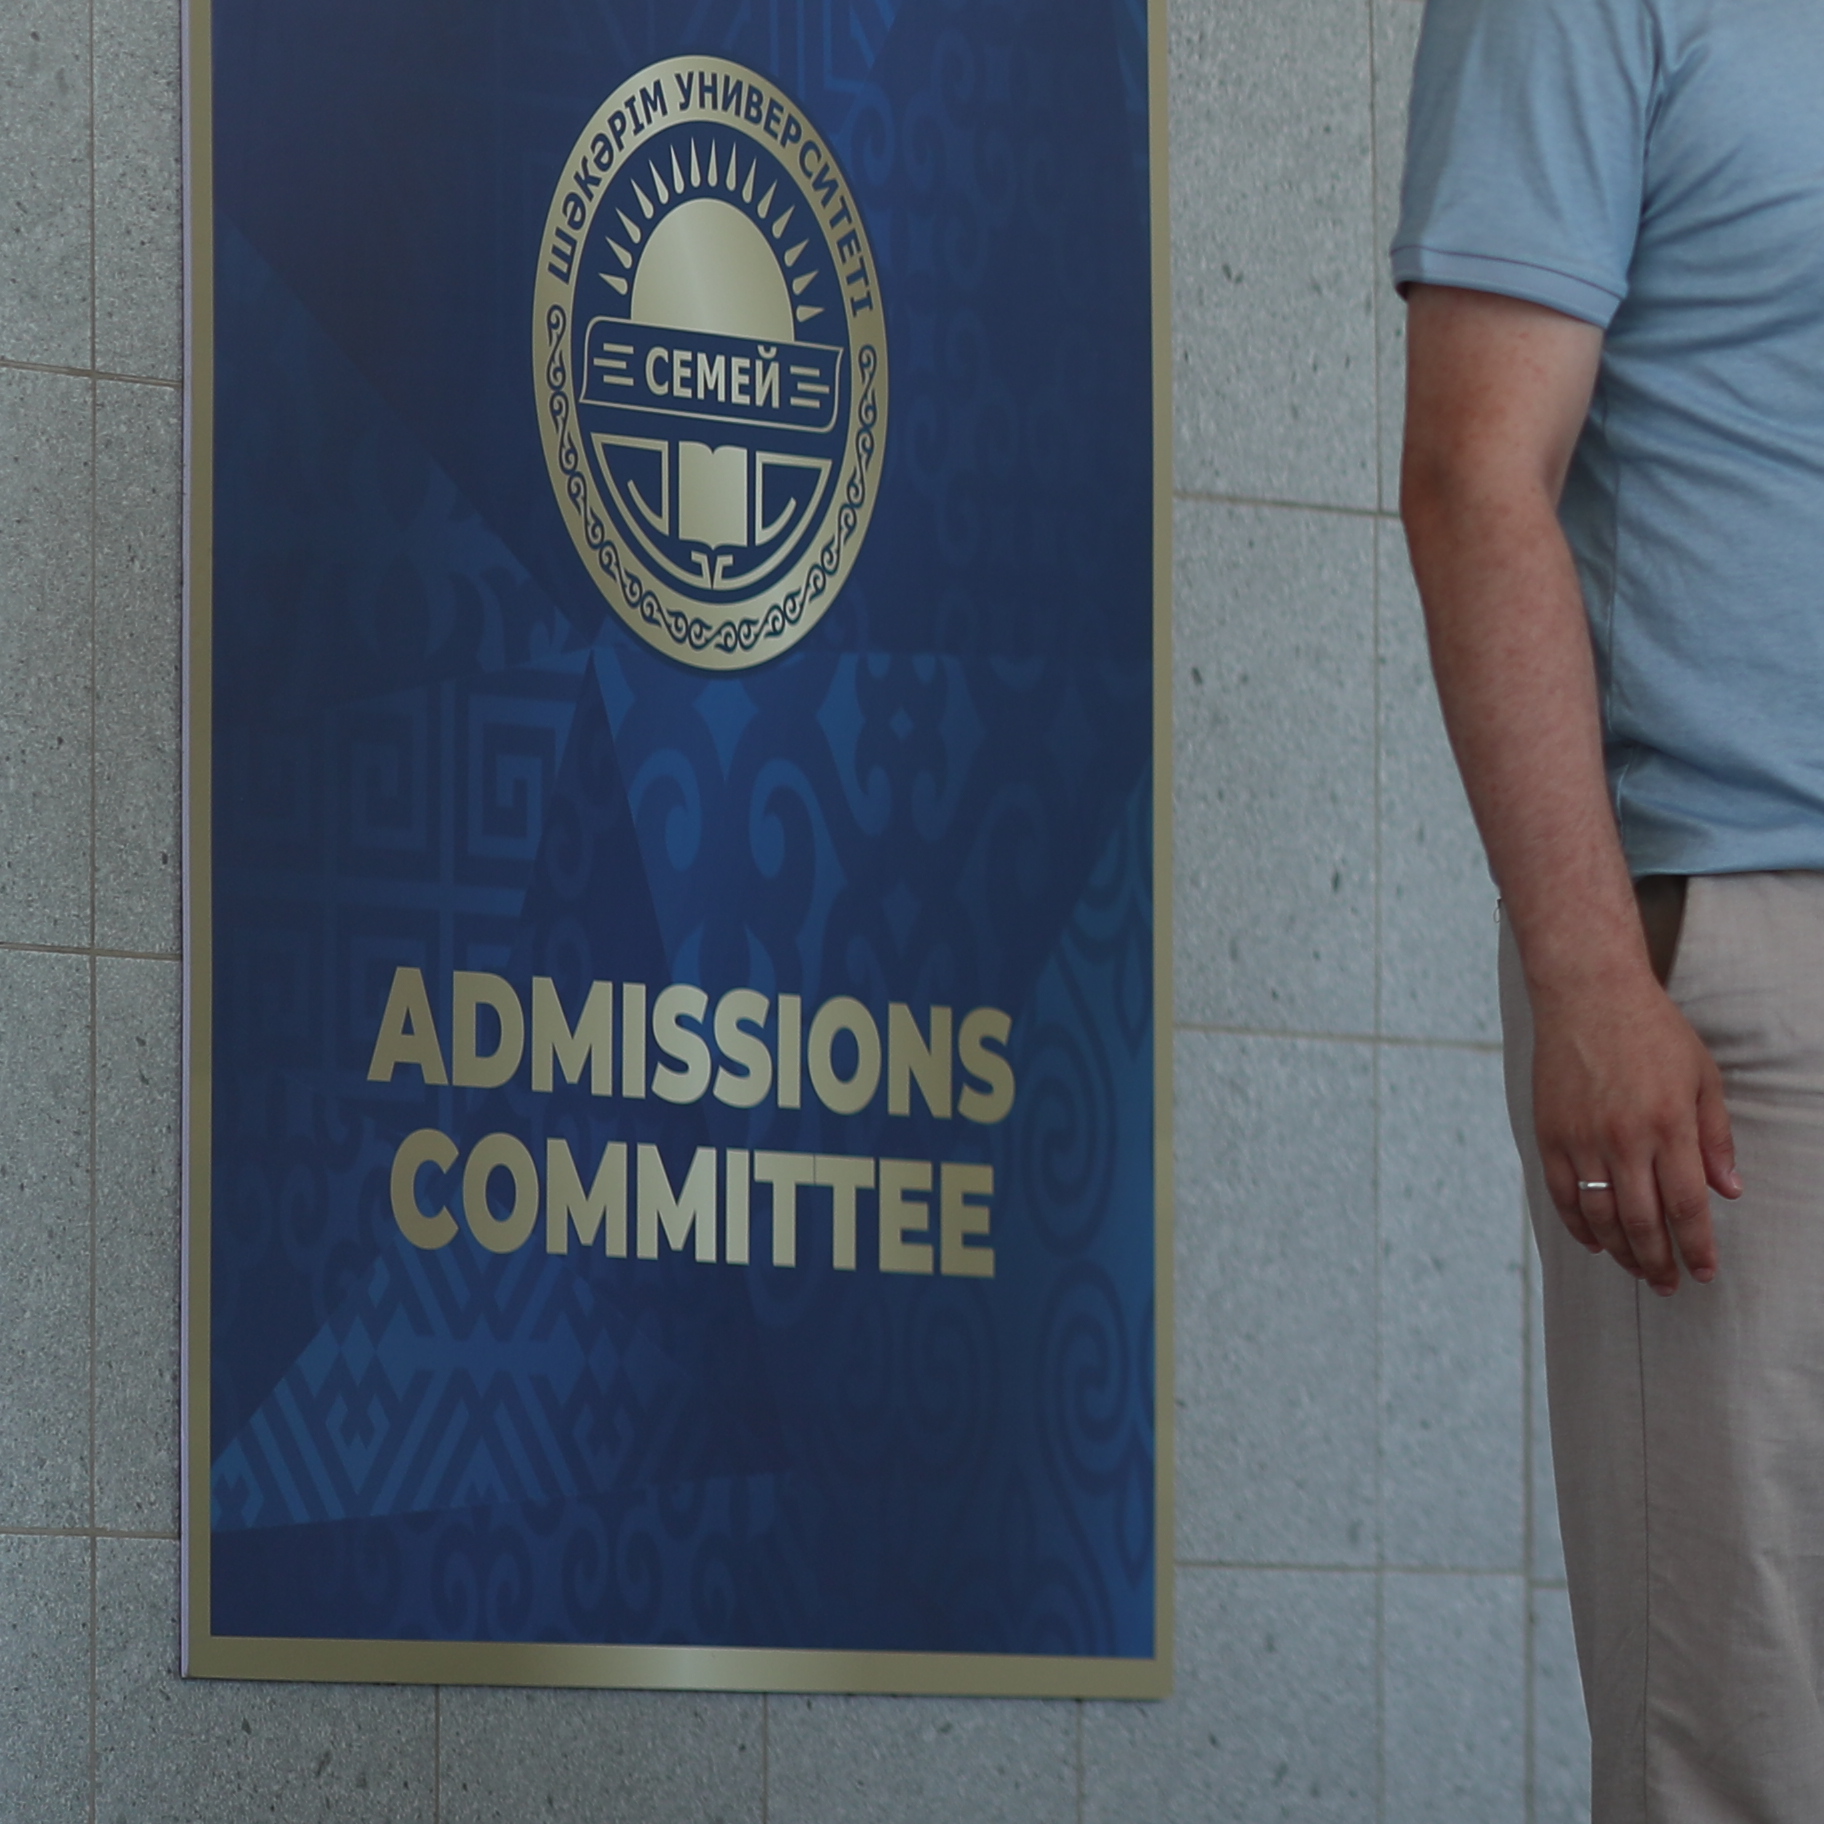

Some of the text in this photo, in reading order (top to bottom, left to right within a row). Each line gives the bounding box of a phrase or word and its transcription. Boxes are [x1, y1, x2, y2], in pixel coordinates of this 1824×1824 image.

[547, 70, 874, 319] ШӘКӘРІМ УНИВЕРСИТЕТІ
[644, 344, 781, 409] СЕМЕЙ
[367, 966, 1016, 1125] ADMISSIONS
[389, 1127, 996, 1278] COMMITTEE
